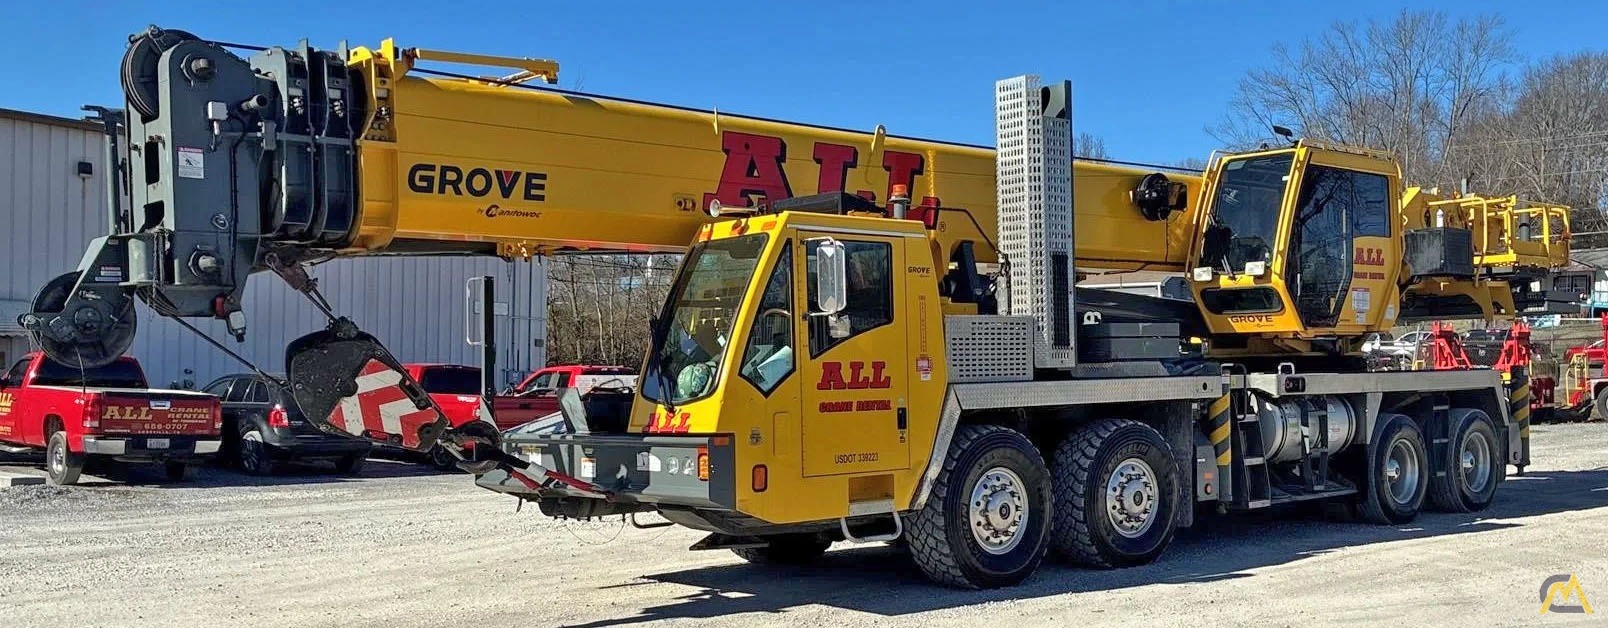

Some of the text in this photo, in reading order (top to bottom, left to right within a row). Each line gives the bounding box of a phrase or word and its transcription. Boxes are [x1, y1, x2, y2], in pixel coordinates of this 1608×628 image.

[407, 163, 547, 201] GROVE
[1354, 247, 1385, 266] ALL
[908, 266, 931, 274] GROVE
[1230, 315, 1273, 323] GROVE
[817, 361, 891, 390] ALL
[102, 406, 153, 420] ALL
[819, 400, 891, 413] CRANE RENTAL
[834, 452, 879, 464] USDOT 339223
